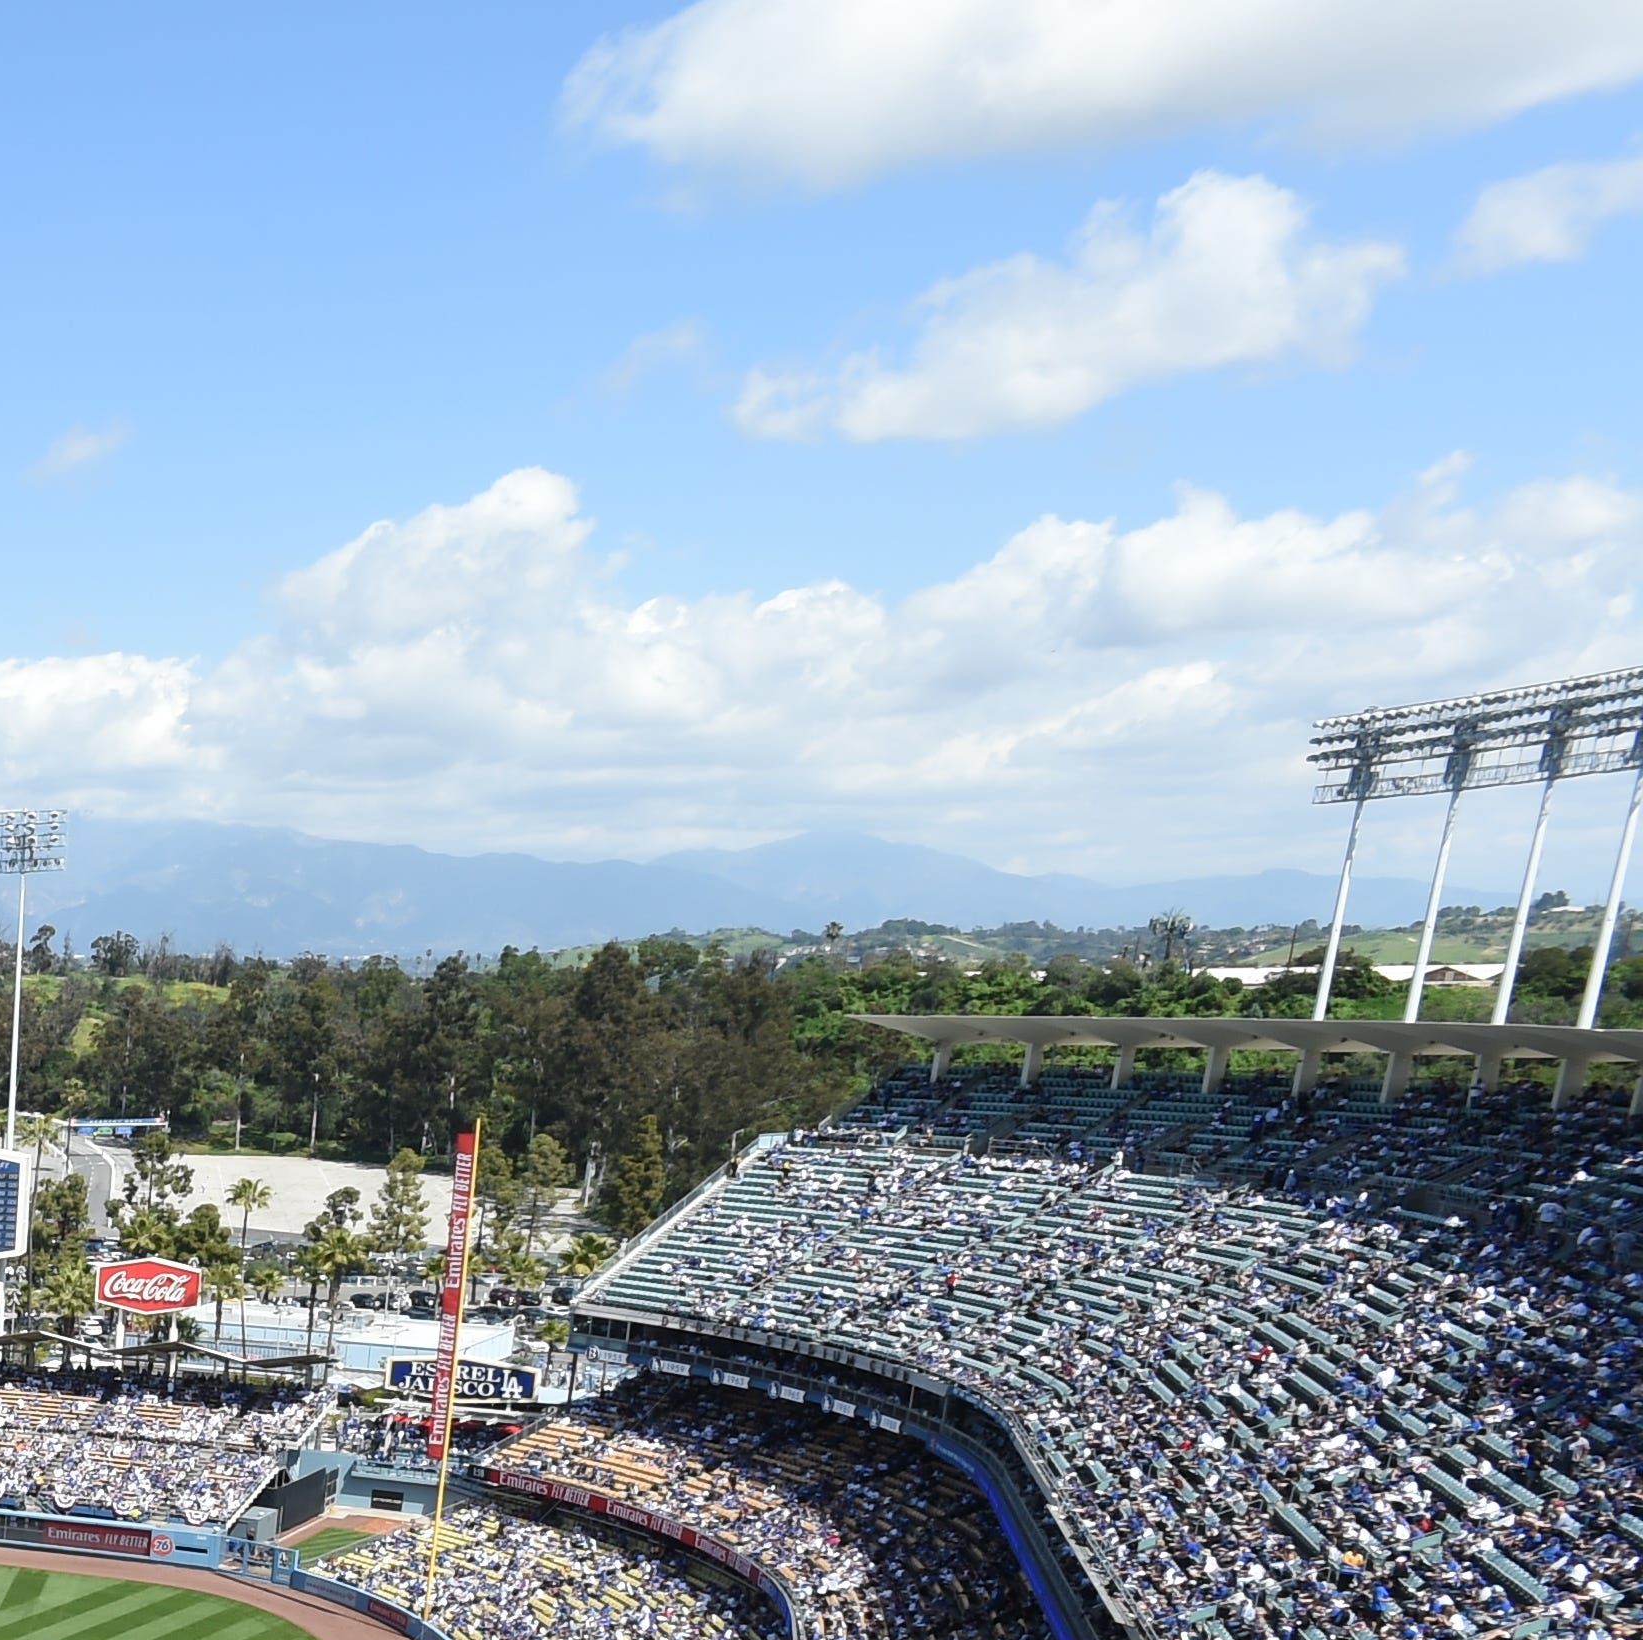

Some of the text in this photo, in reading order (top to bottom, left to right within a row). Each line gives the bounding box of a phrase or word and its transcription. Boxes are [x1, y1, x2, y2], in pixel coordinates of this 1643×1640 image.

[445, 1152, 473, 1290] Emirates FLY BETTER
[103, 1270, 192, 1303] Coca-Cola
[410, 1362, 522, 1399] ESREL LA
[428, 1312, 456, 1447] Emirates FLY BETTER
[499, 1471, 590, 1505] Emirates FLY BETTER
[606, 1500, 683, 1540] Emirates FLY BETTER
[47, 1525, 149, 1550] Emirates FLY BETTER
[154, 1539, 171, 1552] 76
[694, 1533, 728, 1562] Emirates
